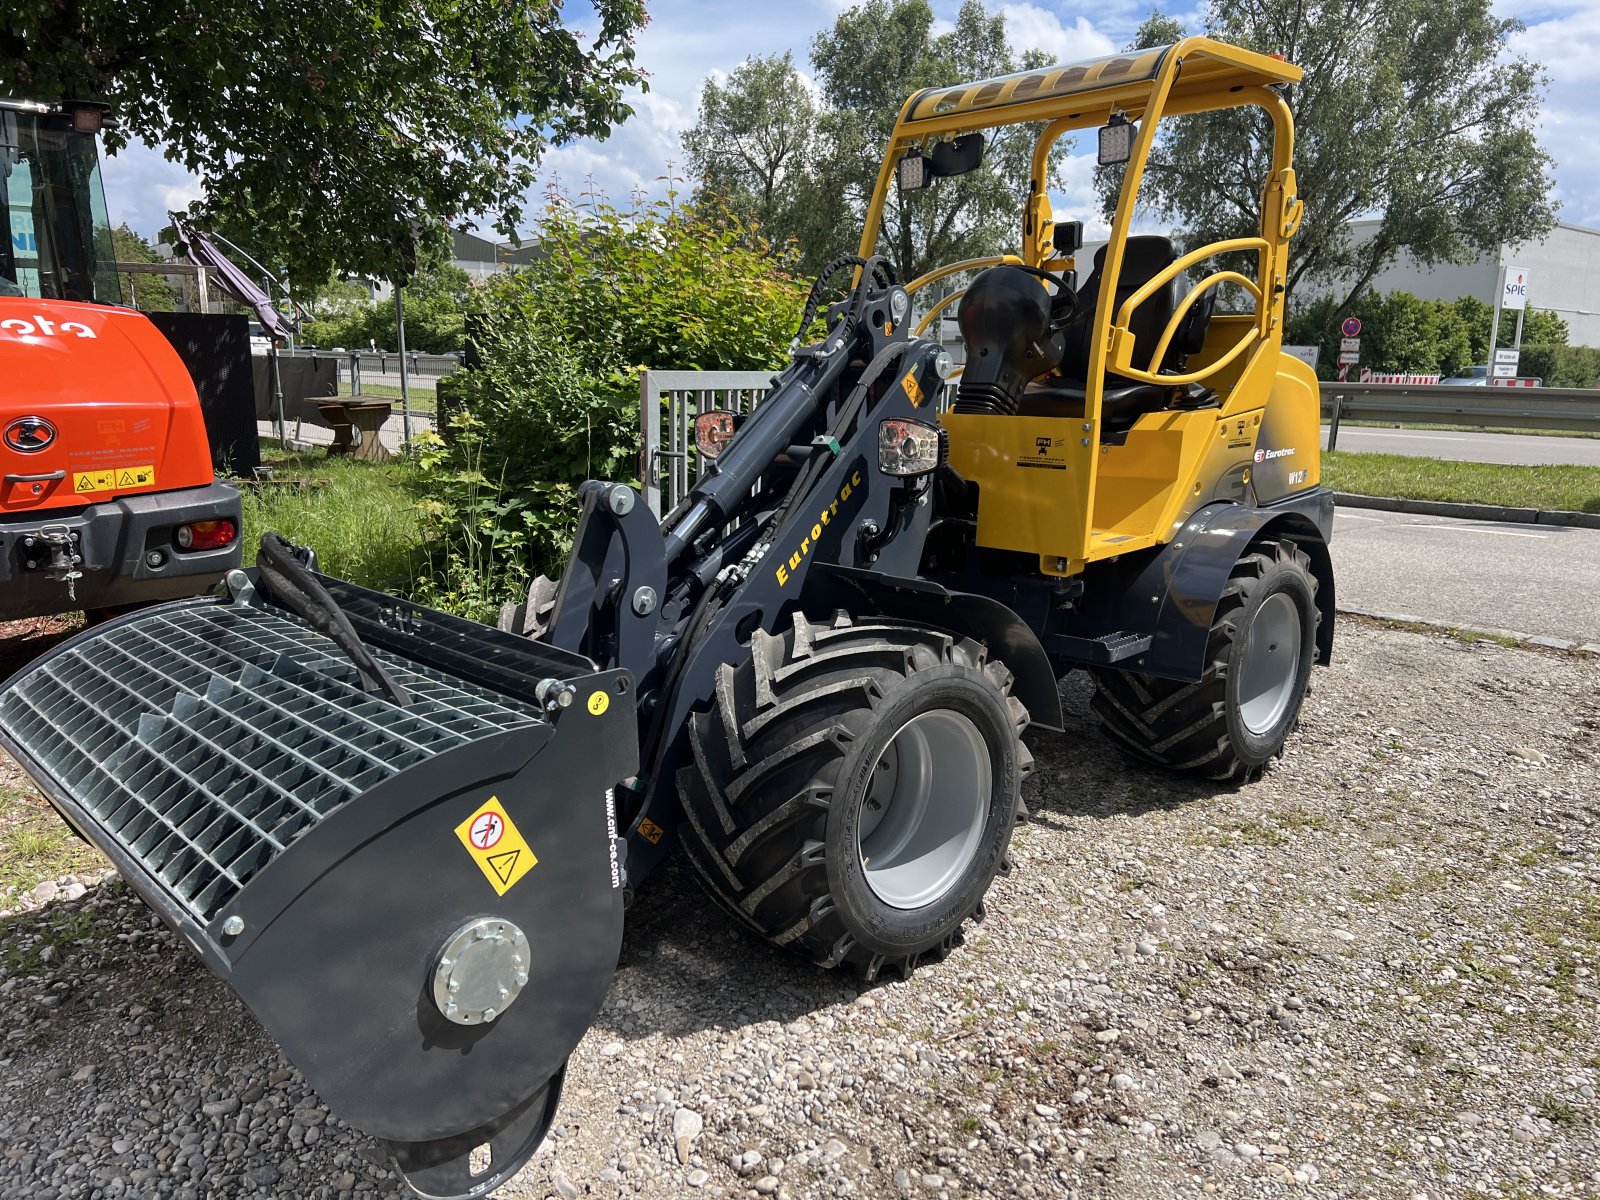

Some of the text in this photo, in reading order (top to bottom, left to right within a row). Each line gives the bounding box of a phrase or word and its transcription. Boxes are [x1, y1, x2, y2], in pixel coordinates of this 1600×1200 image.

[1505, 284, 1526, 295] SPIE
[1265, 448, 1296, 460] Eurotrac
[775, 470, 861, 587] Eurotrac
[605, 788, 620, 888] www.cnf-ce.com
